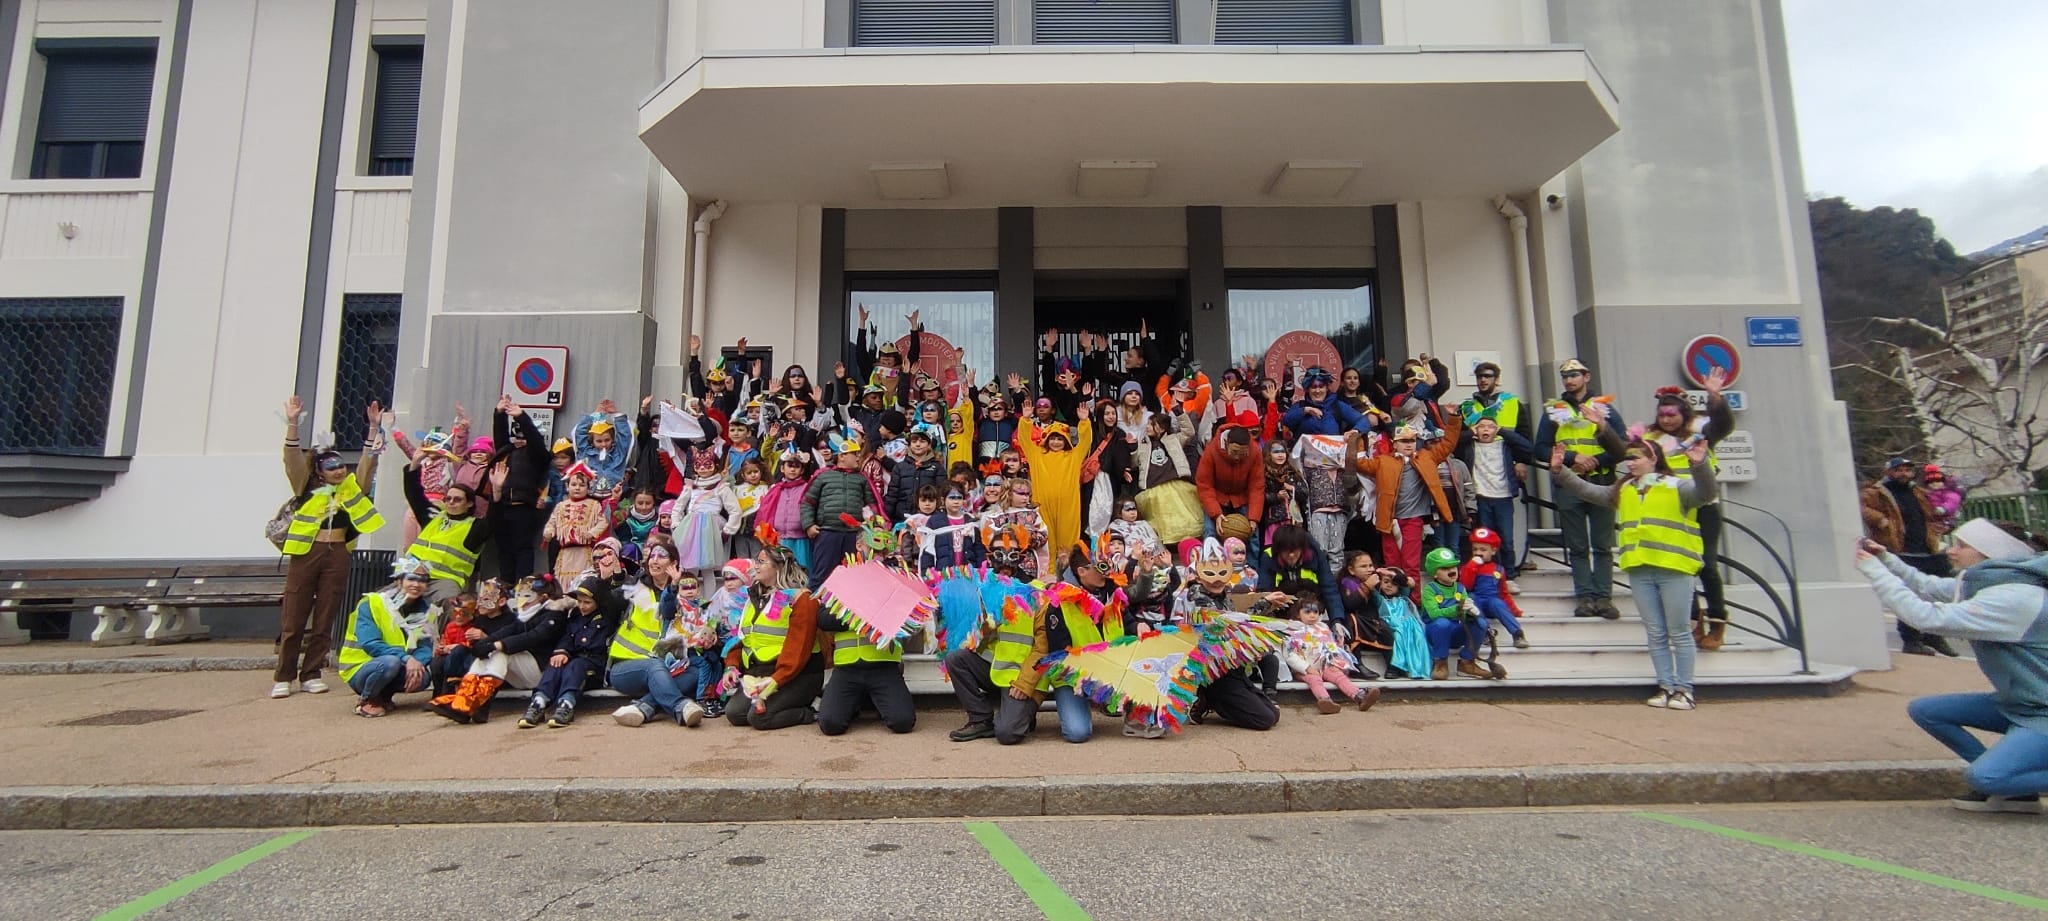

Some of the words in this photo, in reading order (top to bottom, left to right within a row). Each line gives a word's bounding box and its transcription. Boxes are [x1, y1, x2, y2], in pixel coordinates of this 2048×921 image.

[1269, 342, 1285, 365] VILLE
[1286, 336, 1298, 346] DE
[1715, 446, 1752, 454] SCENSEUR
